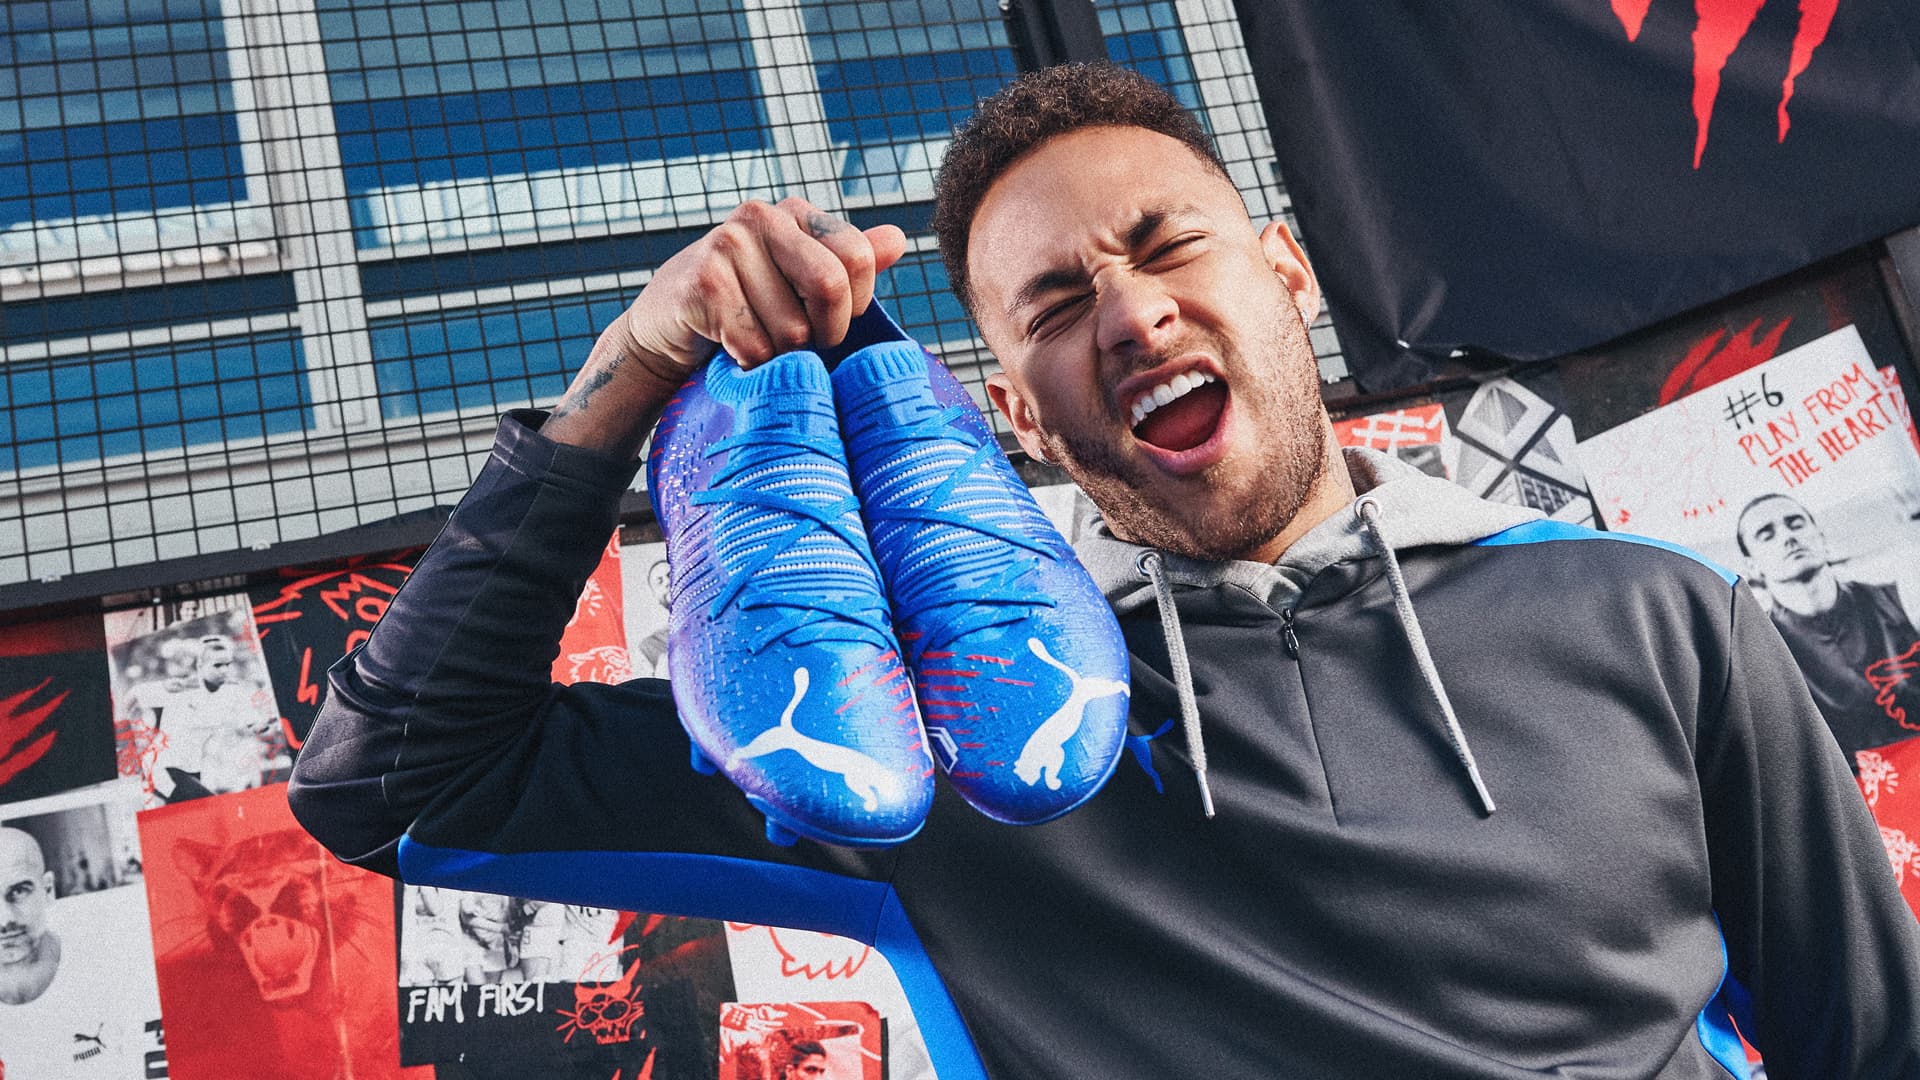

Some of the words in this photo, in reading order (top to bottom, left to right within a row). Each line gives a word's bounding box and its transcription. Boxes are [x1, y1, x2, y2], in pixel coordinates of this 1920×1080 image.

[1722, 372, 1785, 430] #6
[1737, 411, 1801, 466] PLAY
[1801, 362, 1879, 425] FROM
[1768, 448, 1821, 488] THE
[476, 975, 546, 1018] FIRST
